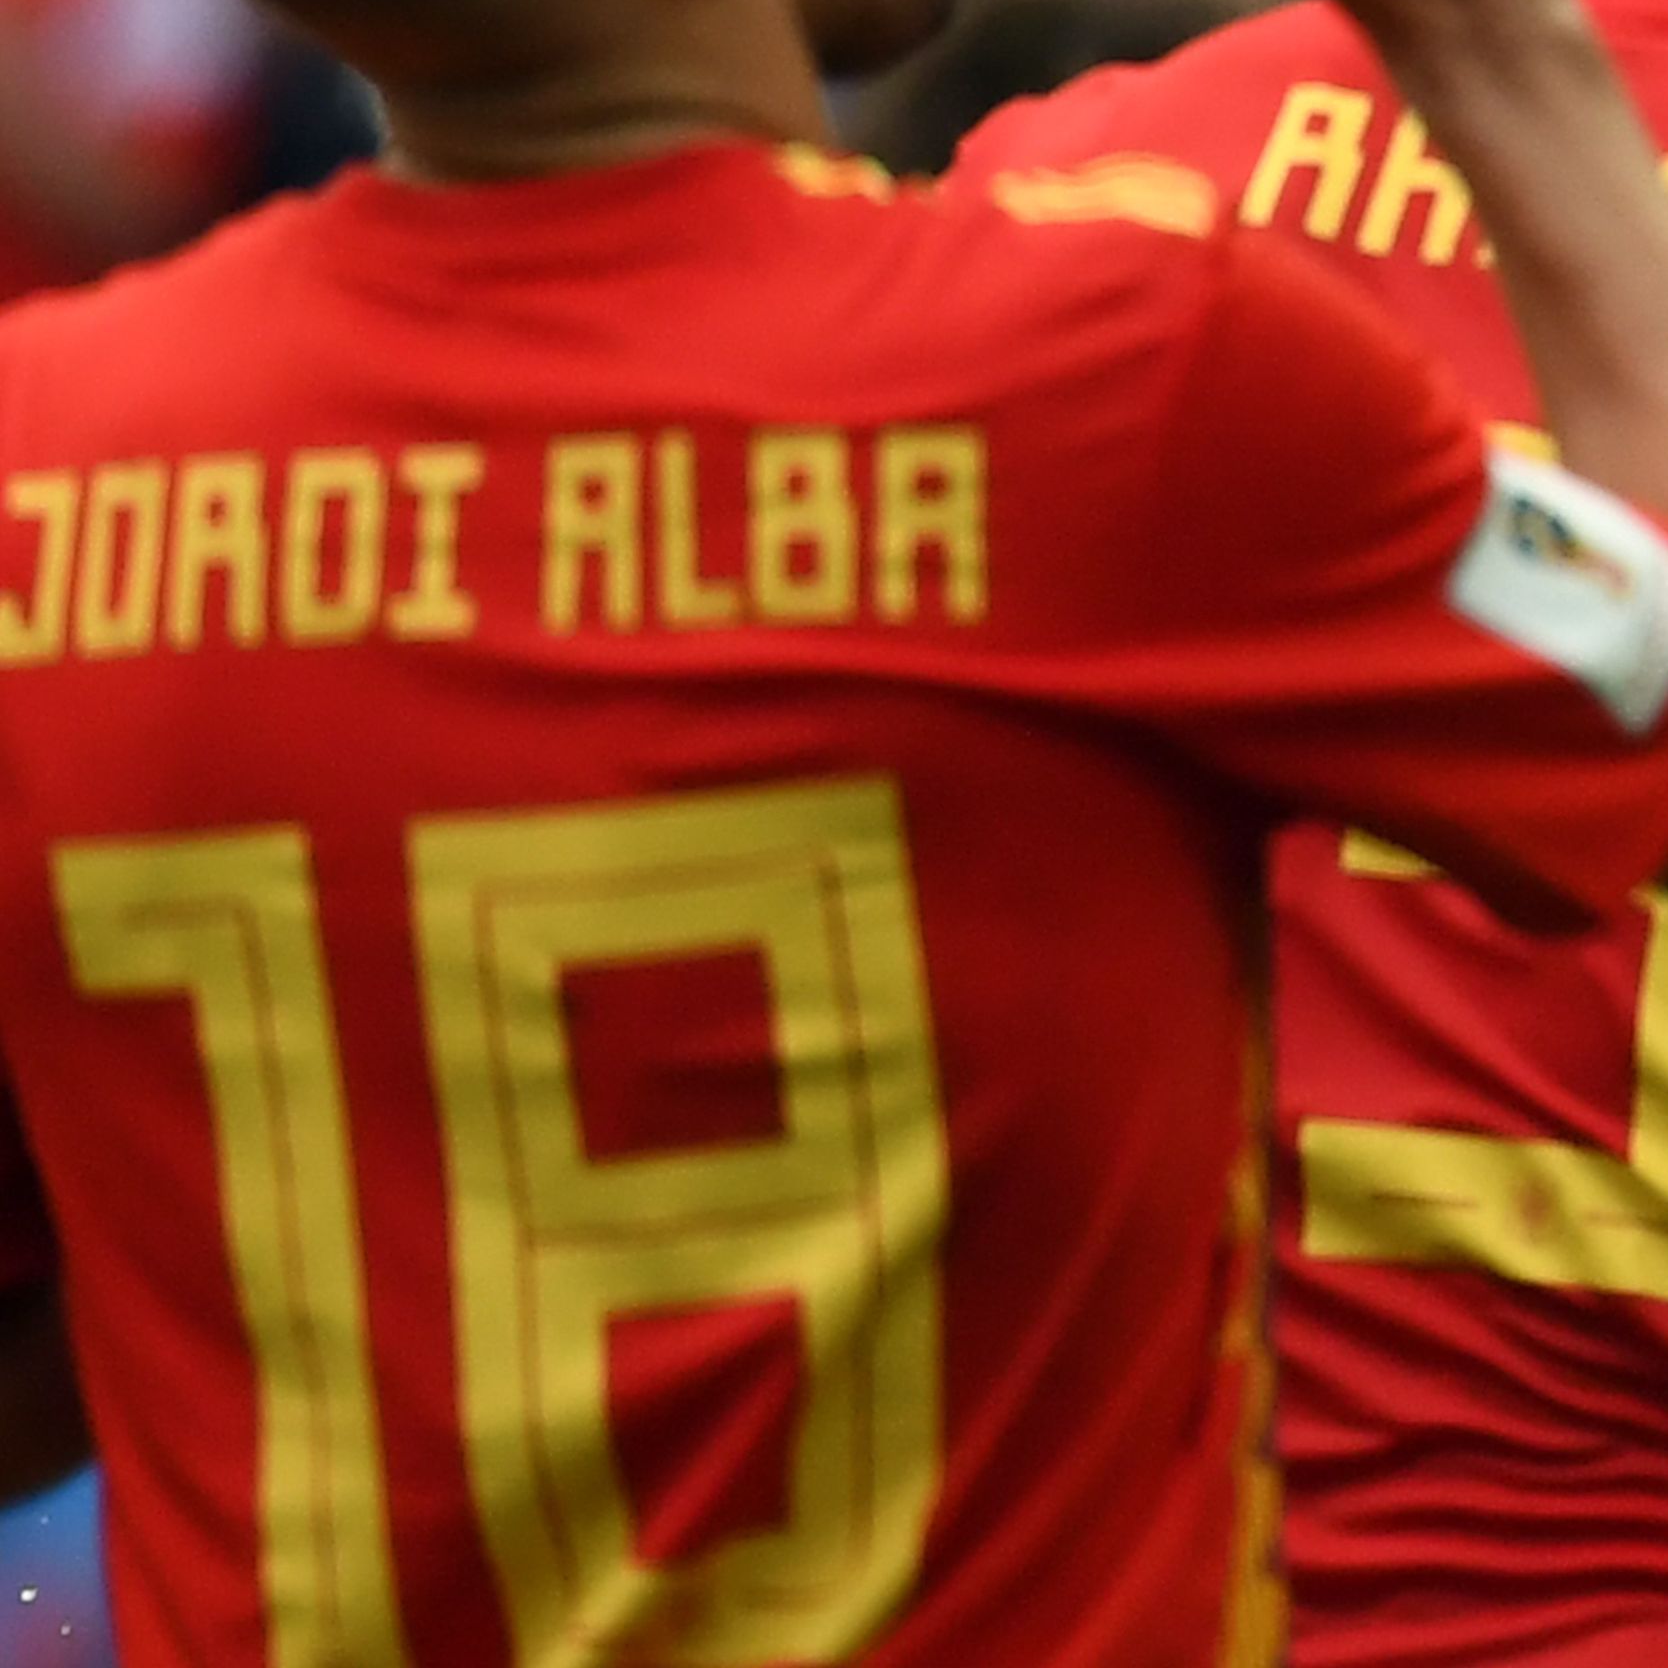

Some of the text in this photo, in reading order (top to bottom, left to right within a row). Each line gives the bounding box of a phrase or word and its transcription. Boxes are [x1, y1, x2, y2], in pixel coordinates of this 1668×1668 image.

[0, 423, 989, 670] JORDI ALBA
[50, 769, 951, 1668] 18
